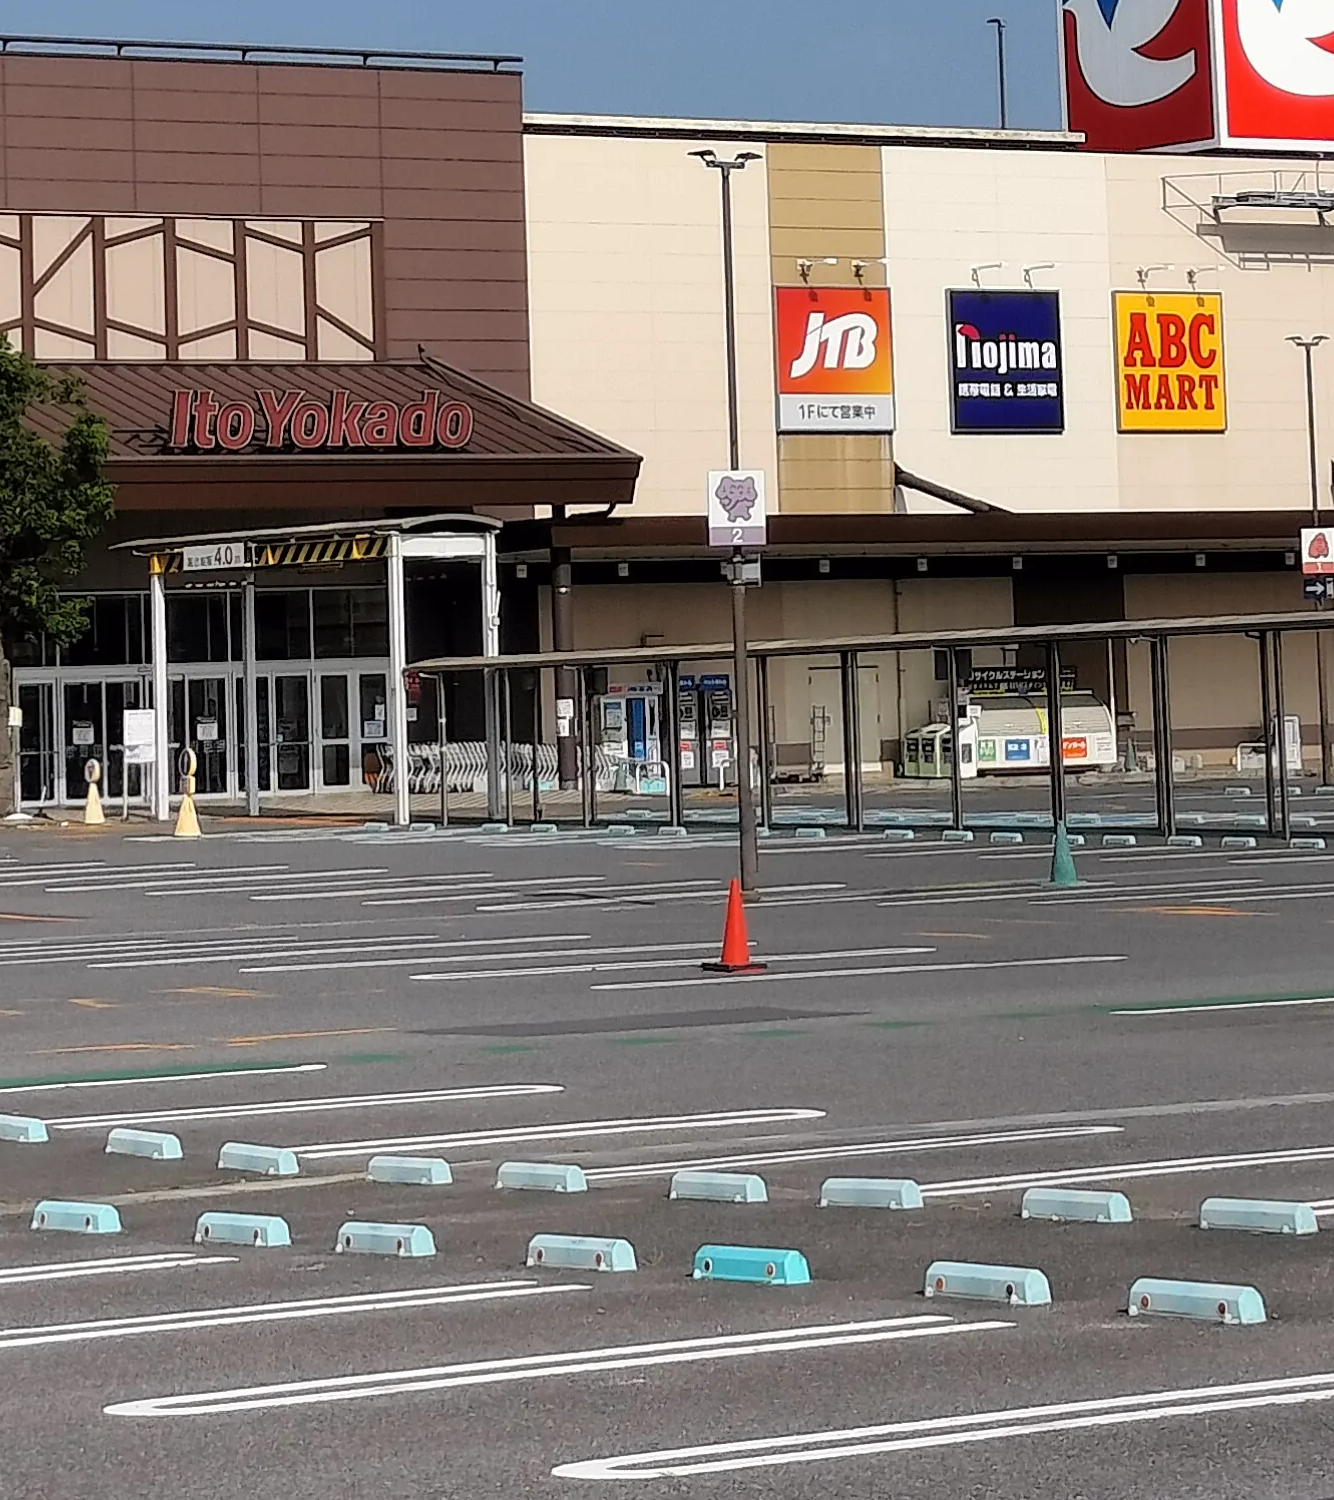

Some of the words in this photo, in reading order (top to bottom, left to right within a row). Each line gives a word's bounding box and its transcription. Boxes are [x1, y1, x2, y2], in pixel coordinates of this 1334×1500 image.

[789, 311, 879, 379] JTB
[1123, 312, 1217, 369] ABC
[797, 403, 877, 421] 1Fにて営業中
[1123, 373, 1219, 411] MART
[170, 389, 474, 450] ItoYokado
[731, 527, 744, 544] 2
